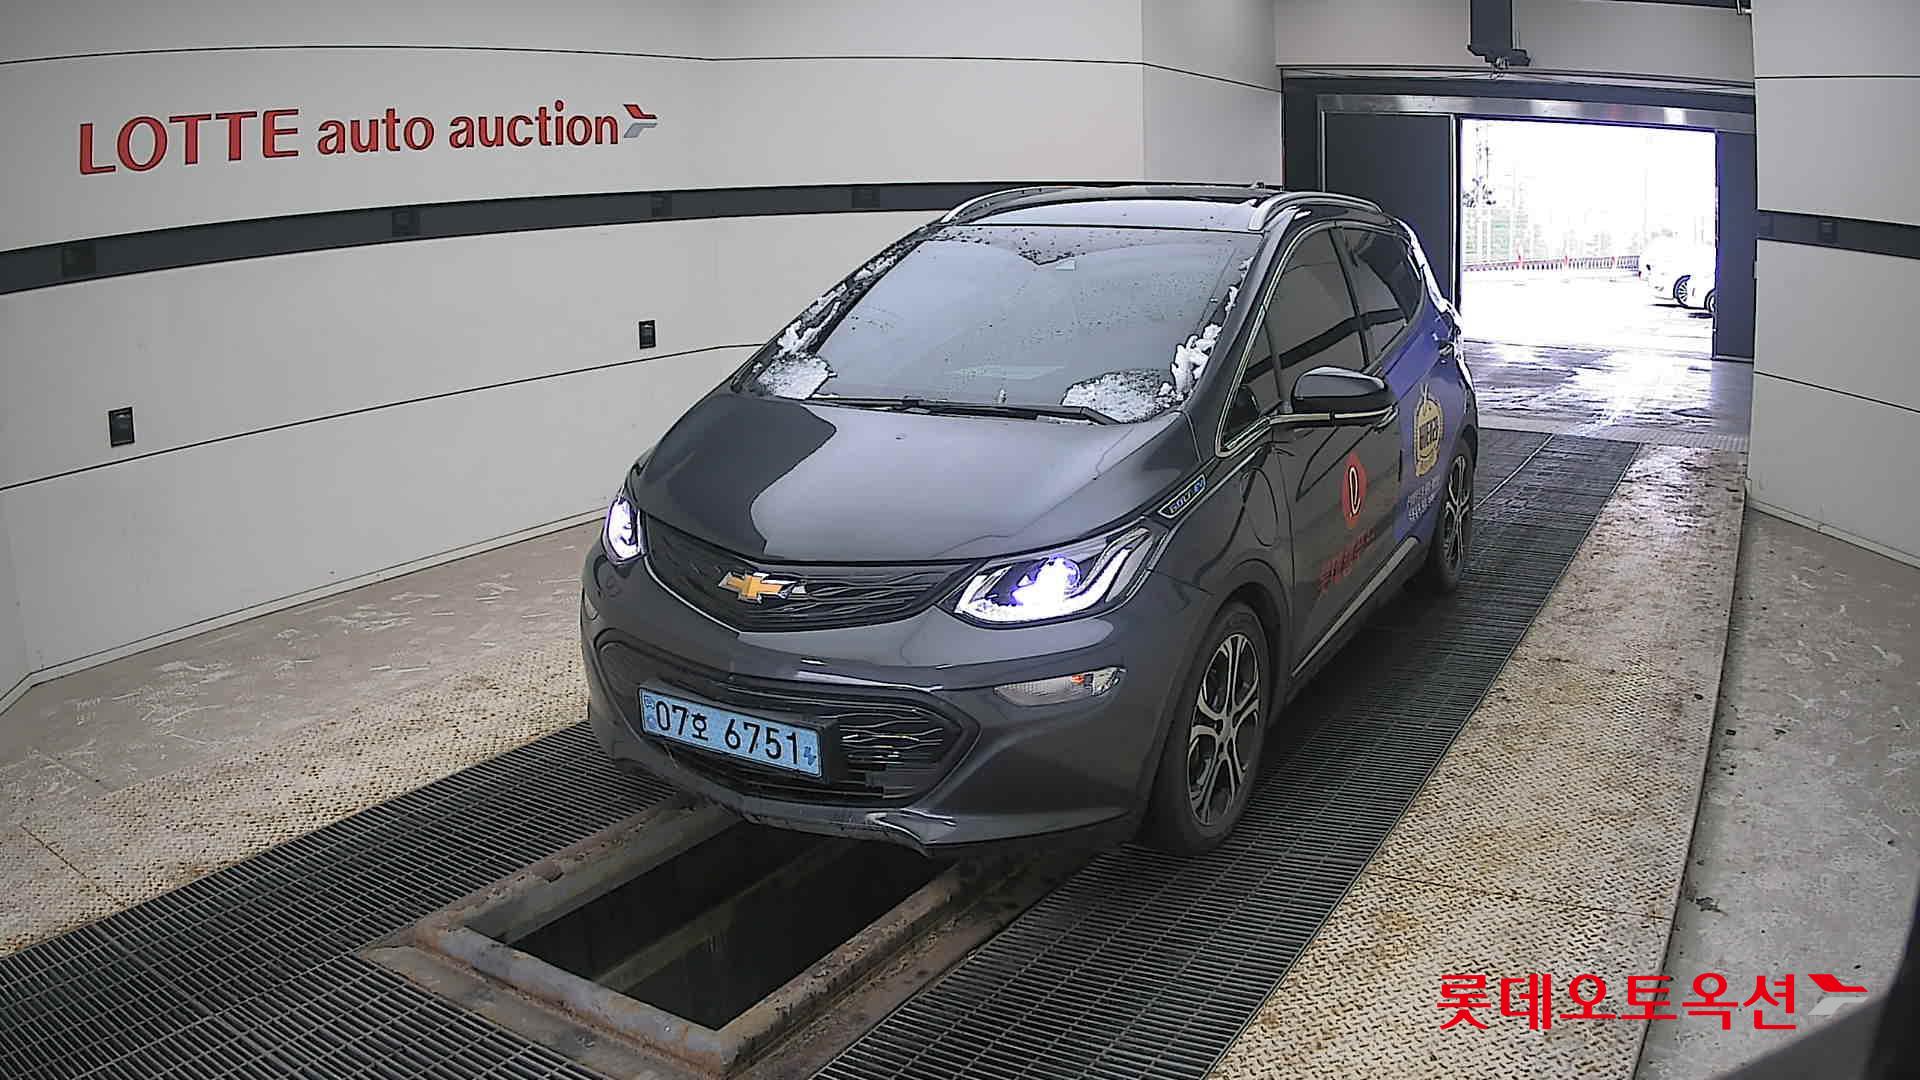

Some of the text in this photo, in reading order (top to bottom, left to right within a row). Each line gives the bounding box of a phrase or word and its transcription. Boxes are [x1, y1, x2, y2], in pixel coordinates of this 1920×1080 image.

[79, 100, 619, 175] LOTTE auto auction
[655, 700, 798, 765] 07호 6751
